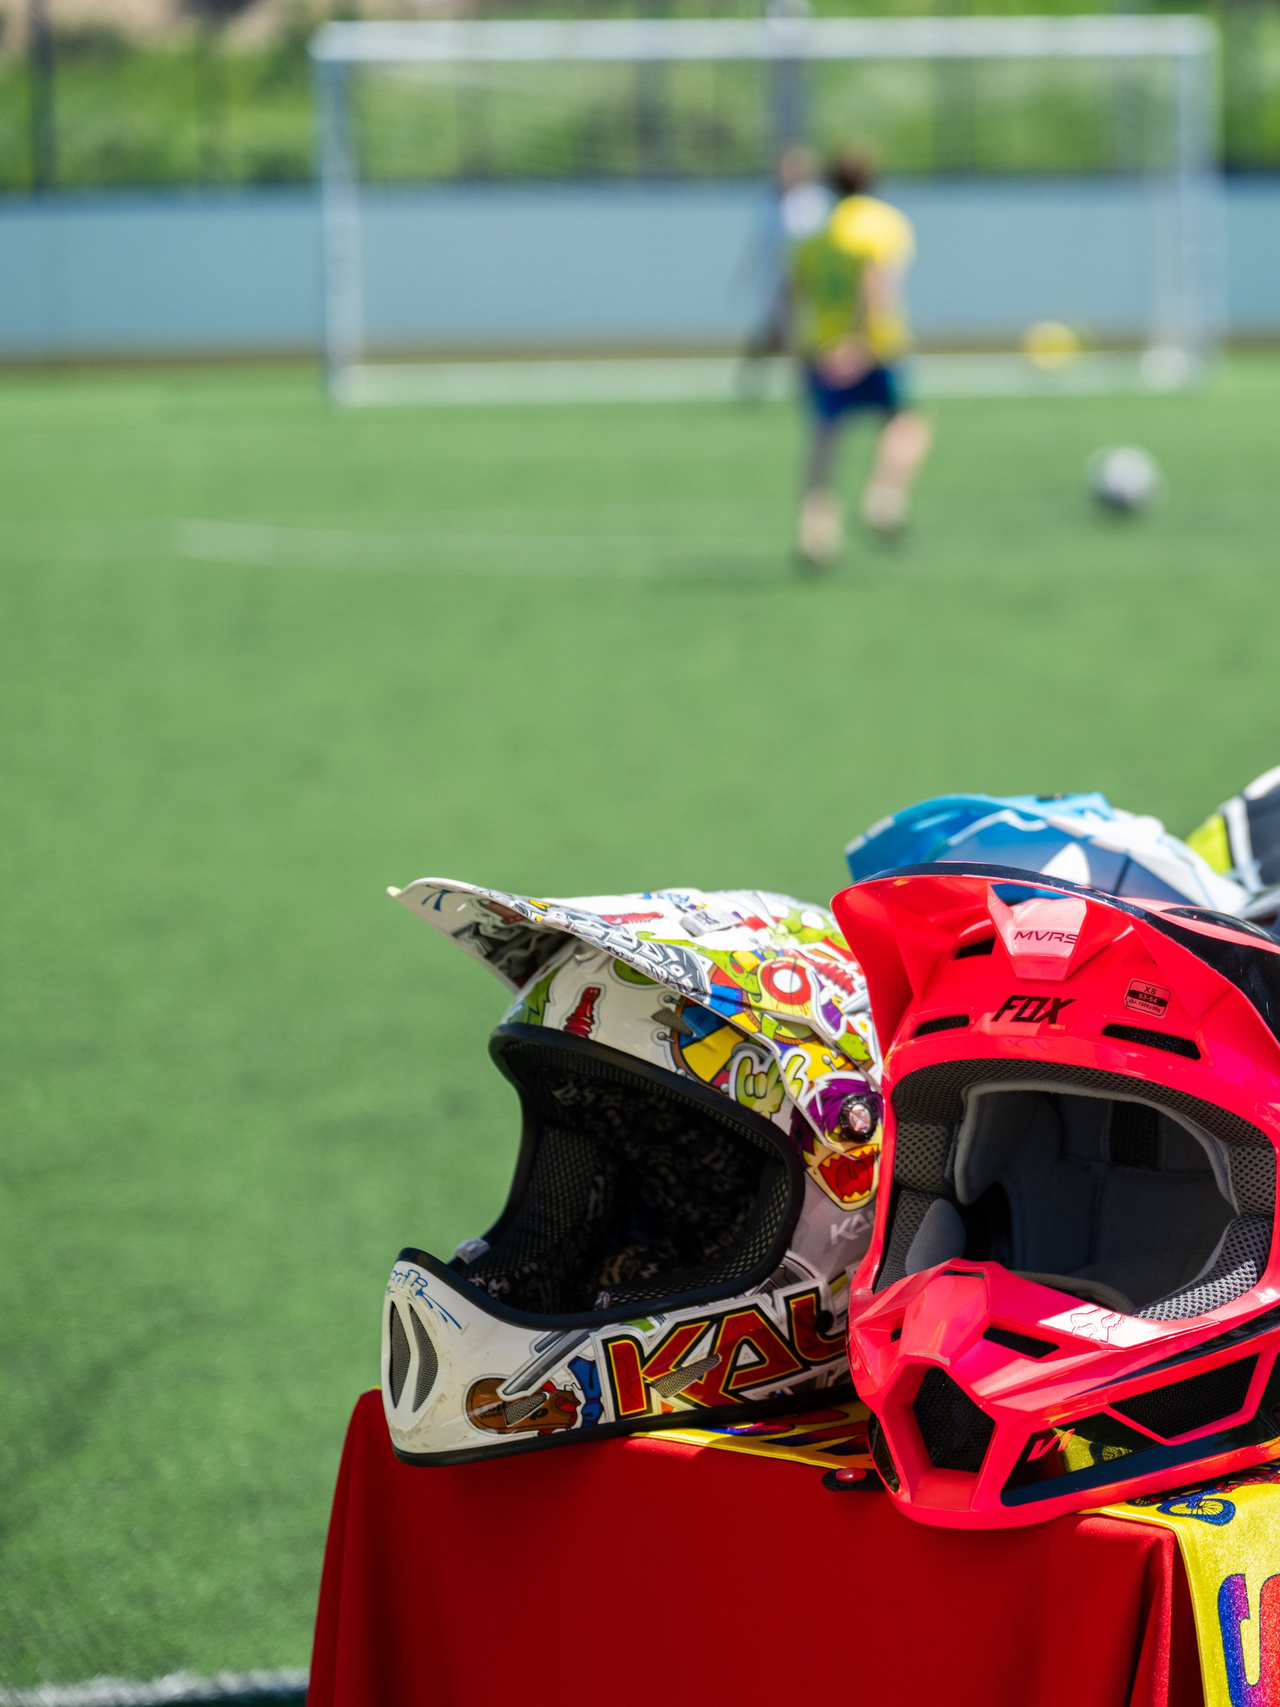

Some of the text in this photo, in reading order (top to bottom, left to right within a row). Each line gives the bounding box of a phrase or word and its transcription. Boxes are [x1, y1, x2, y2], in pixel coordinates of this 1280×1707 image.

[1013, 930, 1079, 945] MVRS
[1144, 986, 1157, 996] XS
[990, 994, 1077, 1026] FOX
